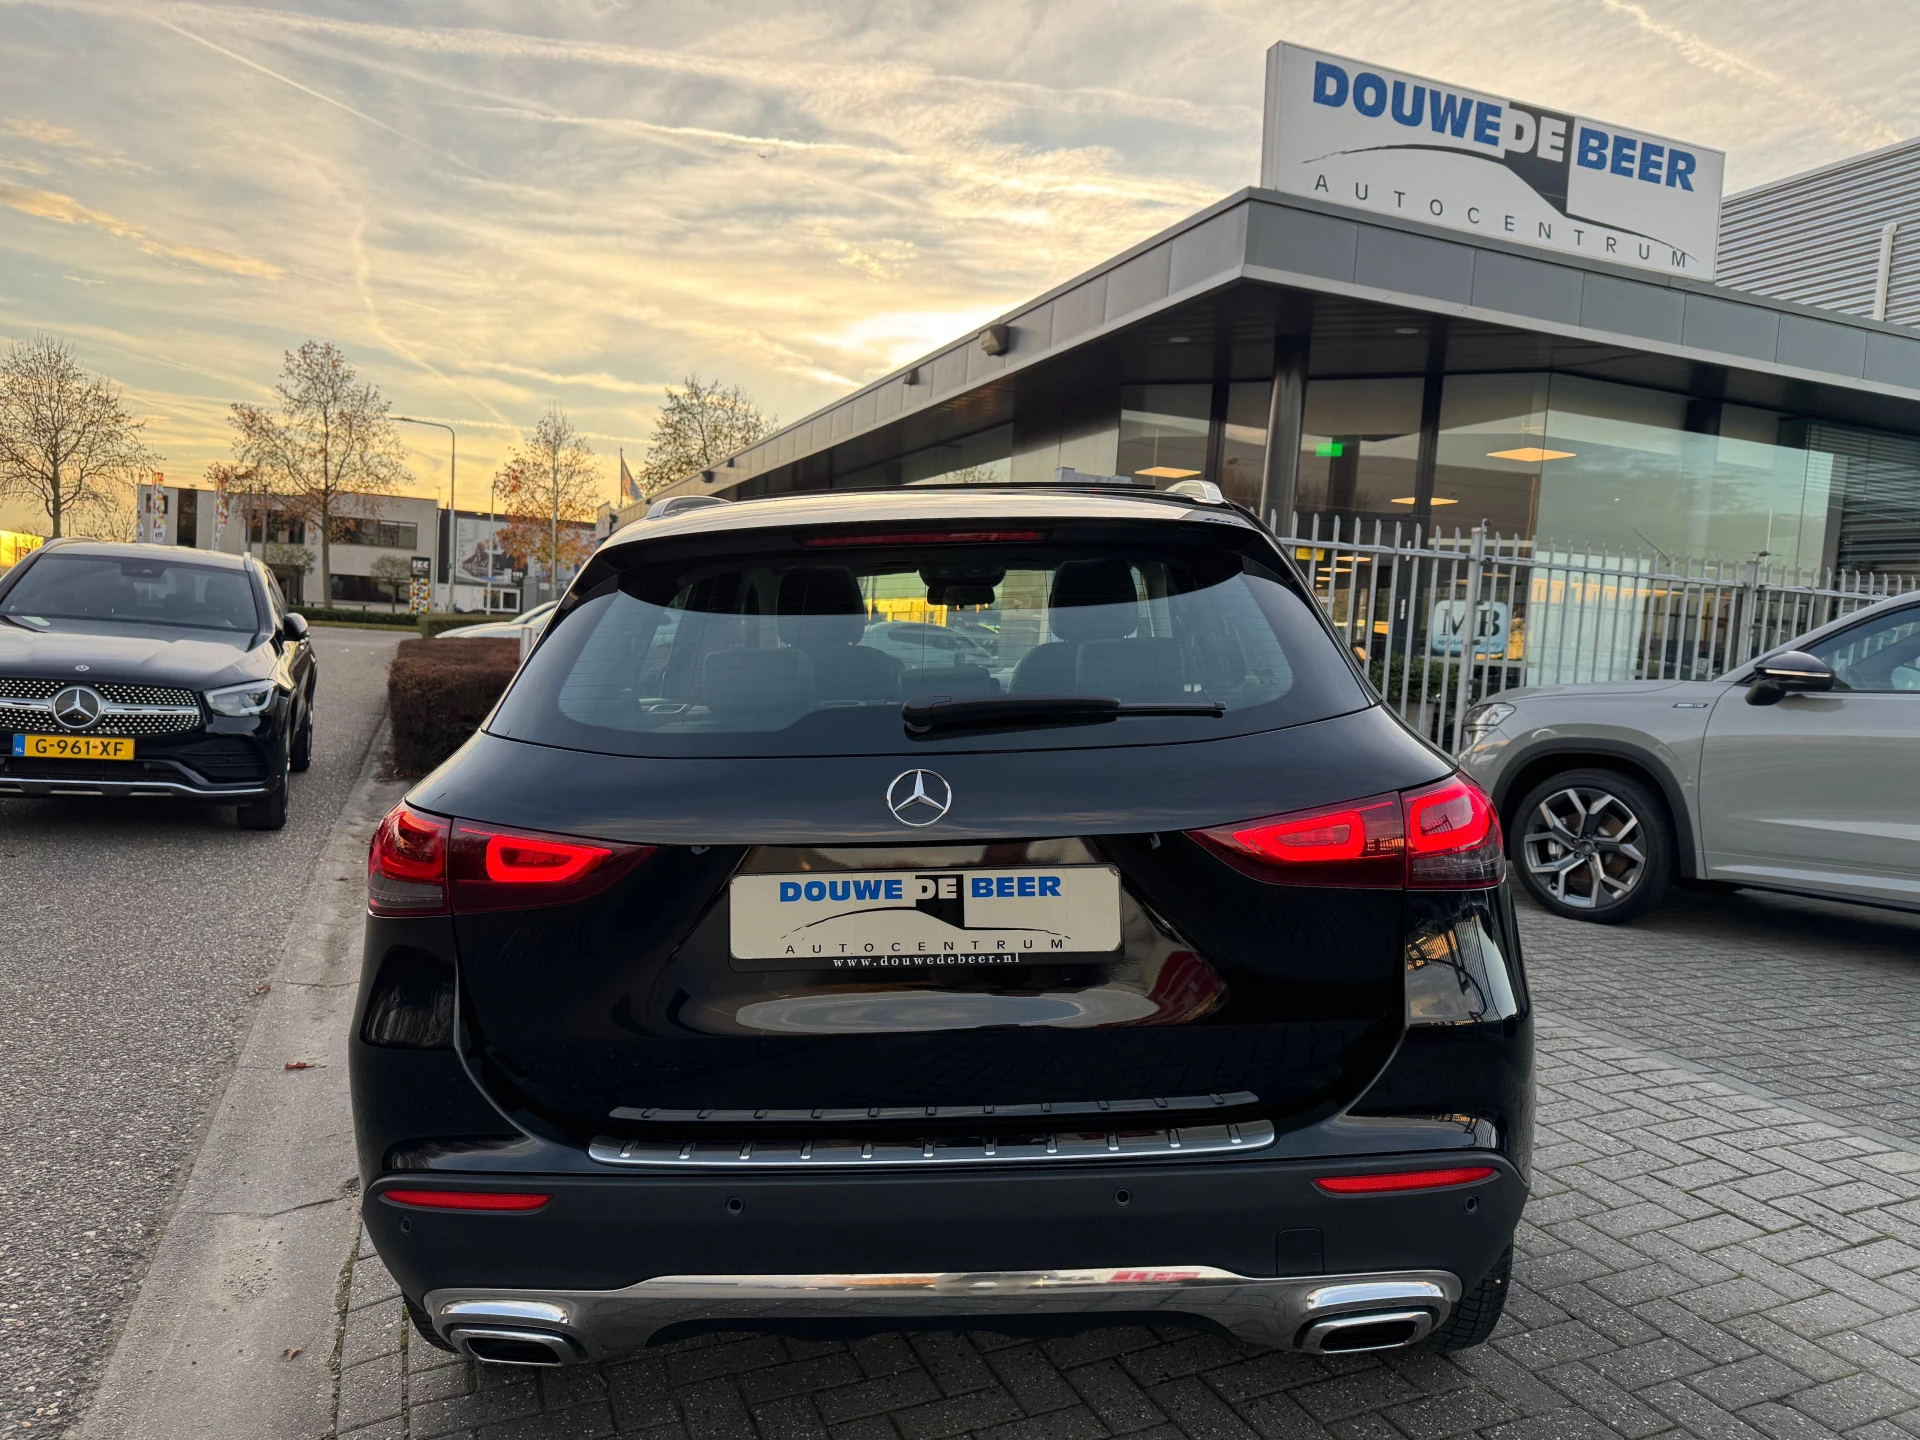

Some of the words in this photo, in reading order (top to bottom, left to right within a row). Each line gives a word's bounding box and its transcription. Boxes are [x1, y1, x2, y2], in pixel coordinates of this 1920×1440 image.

[1313, 60, 1502, 147] DOUWE
[1503, 107, 1567, 162] DE
[1576, 126, 1697, 192] BEER
[1314, 173, 1686, 269] AUTOCENTRUM
[35, 738, 124, 756] G-961-XF
[779, 878, 903, 902] DOUWE
[918, 877, 957, 900] DE
[971, 876, 1062, 898] BEER
[785, 939, 1064, 954] AUTOCENTRUM
[833, 952, 1021, 967] www.douwedebeer.nl
